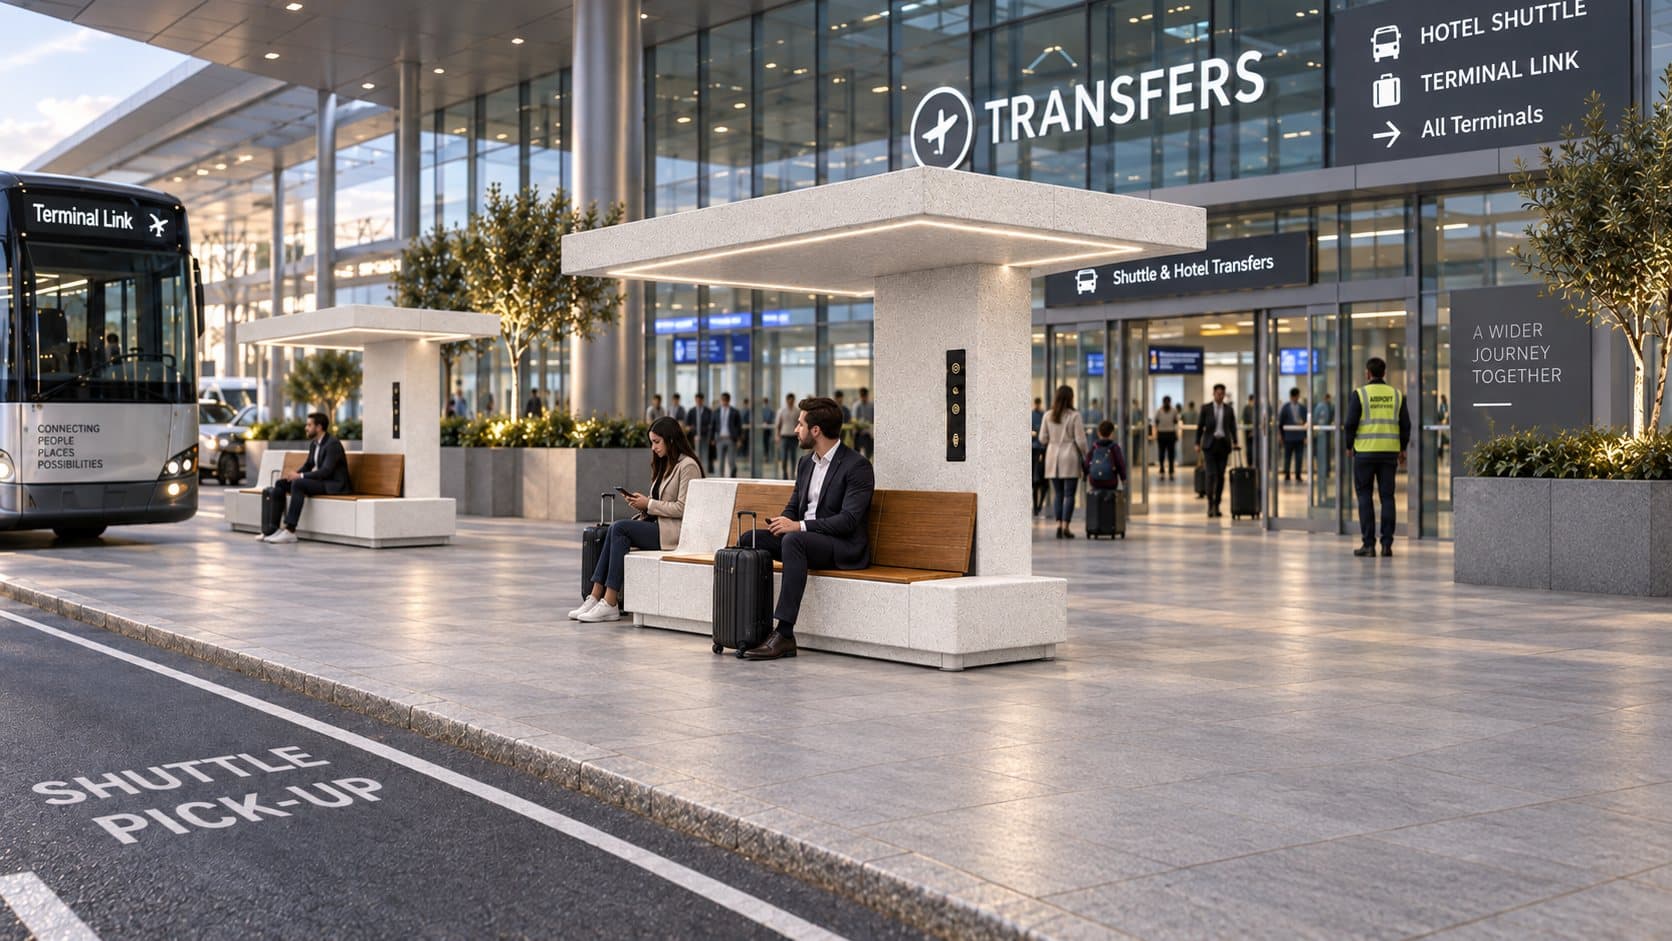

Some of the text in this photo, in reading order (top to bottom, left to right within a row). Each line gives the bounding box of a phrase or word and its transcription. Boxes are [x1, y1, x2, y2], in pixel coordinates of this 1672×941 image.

[1421, 0, 1587, 44] HOTEL SHUTTLE
[1421, 50, 1580, 92] TERMINAL LINK
[984, 49, 1265, 144] TRANSFERS
[1421, 105, 1544, 139] All Terminals
[33, 203, 133, 230] Terminal Link
[1113, 254, 1274, 285] Shuttle & Hotel Transfers
[1472, 322, 1543, 340] A WIDER
[1472, 345, 1550, 363] JOURNEY
[1472, 367, 1562, 385] TOGETHER
[37, 424, 100, 434] CONNECTING
[37, 436, 75, 446] PEOPLE
[37, 448, 75, 458] PLACES
[37, 459, 104, 469] POSSIBILITIES
[31, 745, 331, 806] SHUTTLE
[92, 777, 384, 845] PICK-UP
